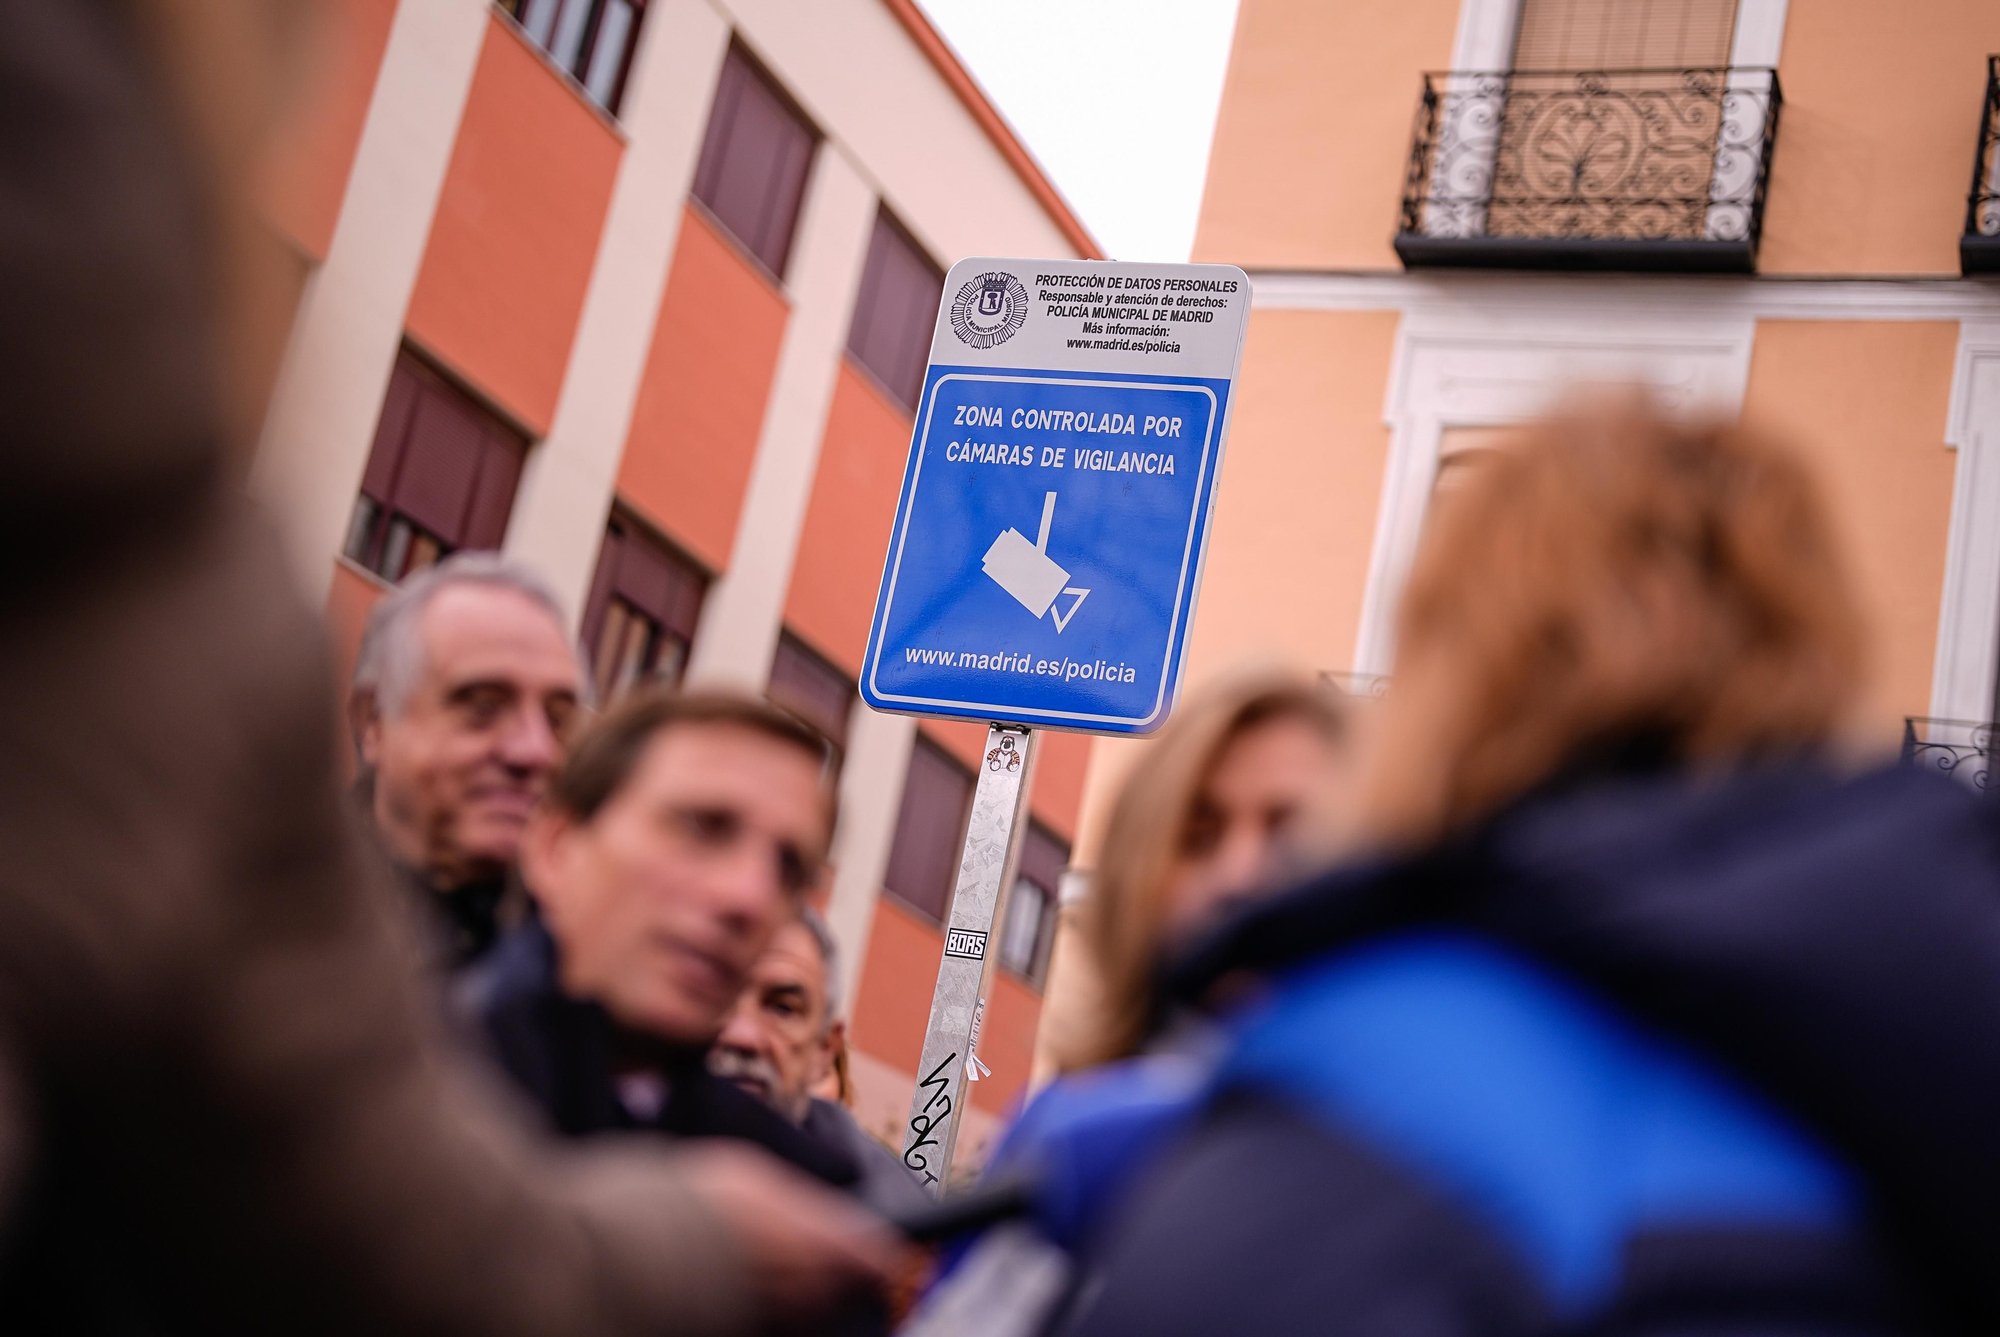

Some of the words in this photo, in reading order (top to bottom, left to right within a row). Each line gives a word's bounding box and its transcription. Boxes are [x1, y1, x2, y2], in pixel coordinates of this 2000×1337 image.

[1036, 274, 1105, 288] PROTECCIÓN
[1107, 277, 1123, 288] DE
[1125, 278, 1161, 290] DATOS
[1164, 279, 1237, 292] PERSONALES
[1039, 290, 1103, 304] Responsable
[1105, 295, 1112, 306] y
[1115, 294, 1158, 305] atención
[1161, 295, 1173, 306] de
[1176, 295, 1227, 308] derechos:
[968, 321, 1003, 333] MUNICIPAL
[1002, 297, 1012, 324] MADRID
[1047, 304, 1088, 318] POLICÍA
[1092, 307, 1149, 320] MUNICIPAL
[1152, 310, 1168, 321] DE
[1170, 310, 1213, 322] MADRID
[1083, 322, 1103, 333] Más
[1106, 323, 1170, 336] información:
[1067, 339, 1180, 354] www.madrid.es/policia
[954, 406, 1002, 427] ZONA
[1012, 409, 1134, 434] CONTROLADA
[1143, 416, 1181, 437] POR
[947, 438, 1034, 465] CÁMARAS
[1041, 447, 1066, 467] DE
[1075, 449, 1174, 475] VIGILANCIA
[907, 648, 1135, 682] www.madrid.es/policia
[947, 933, 985, 954] BOAS
